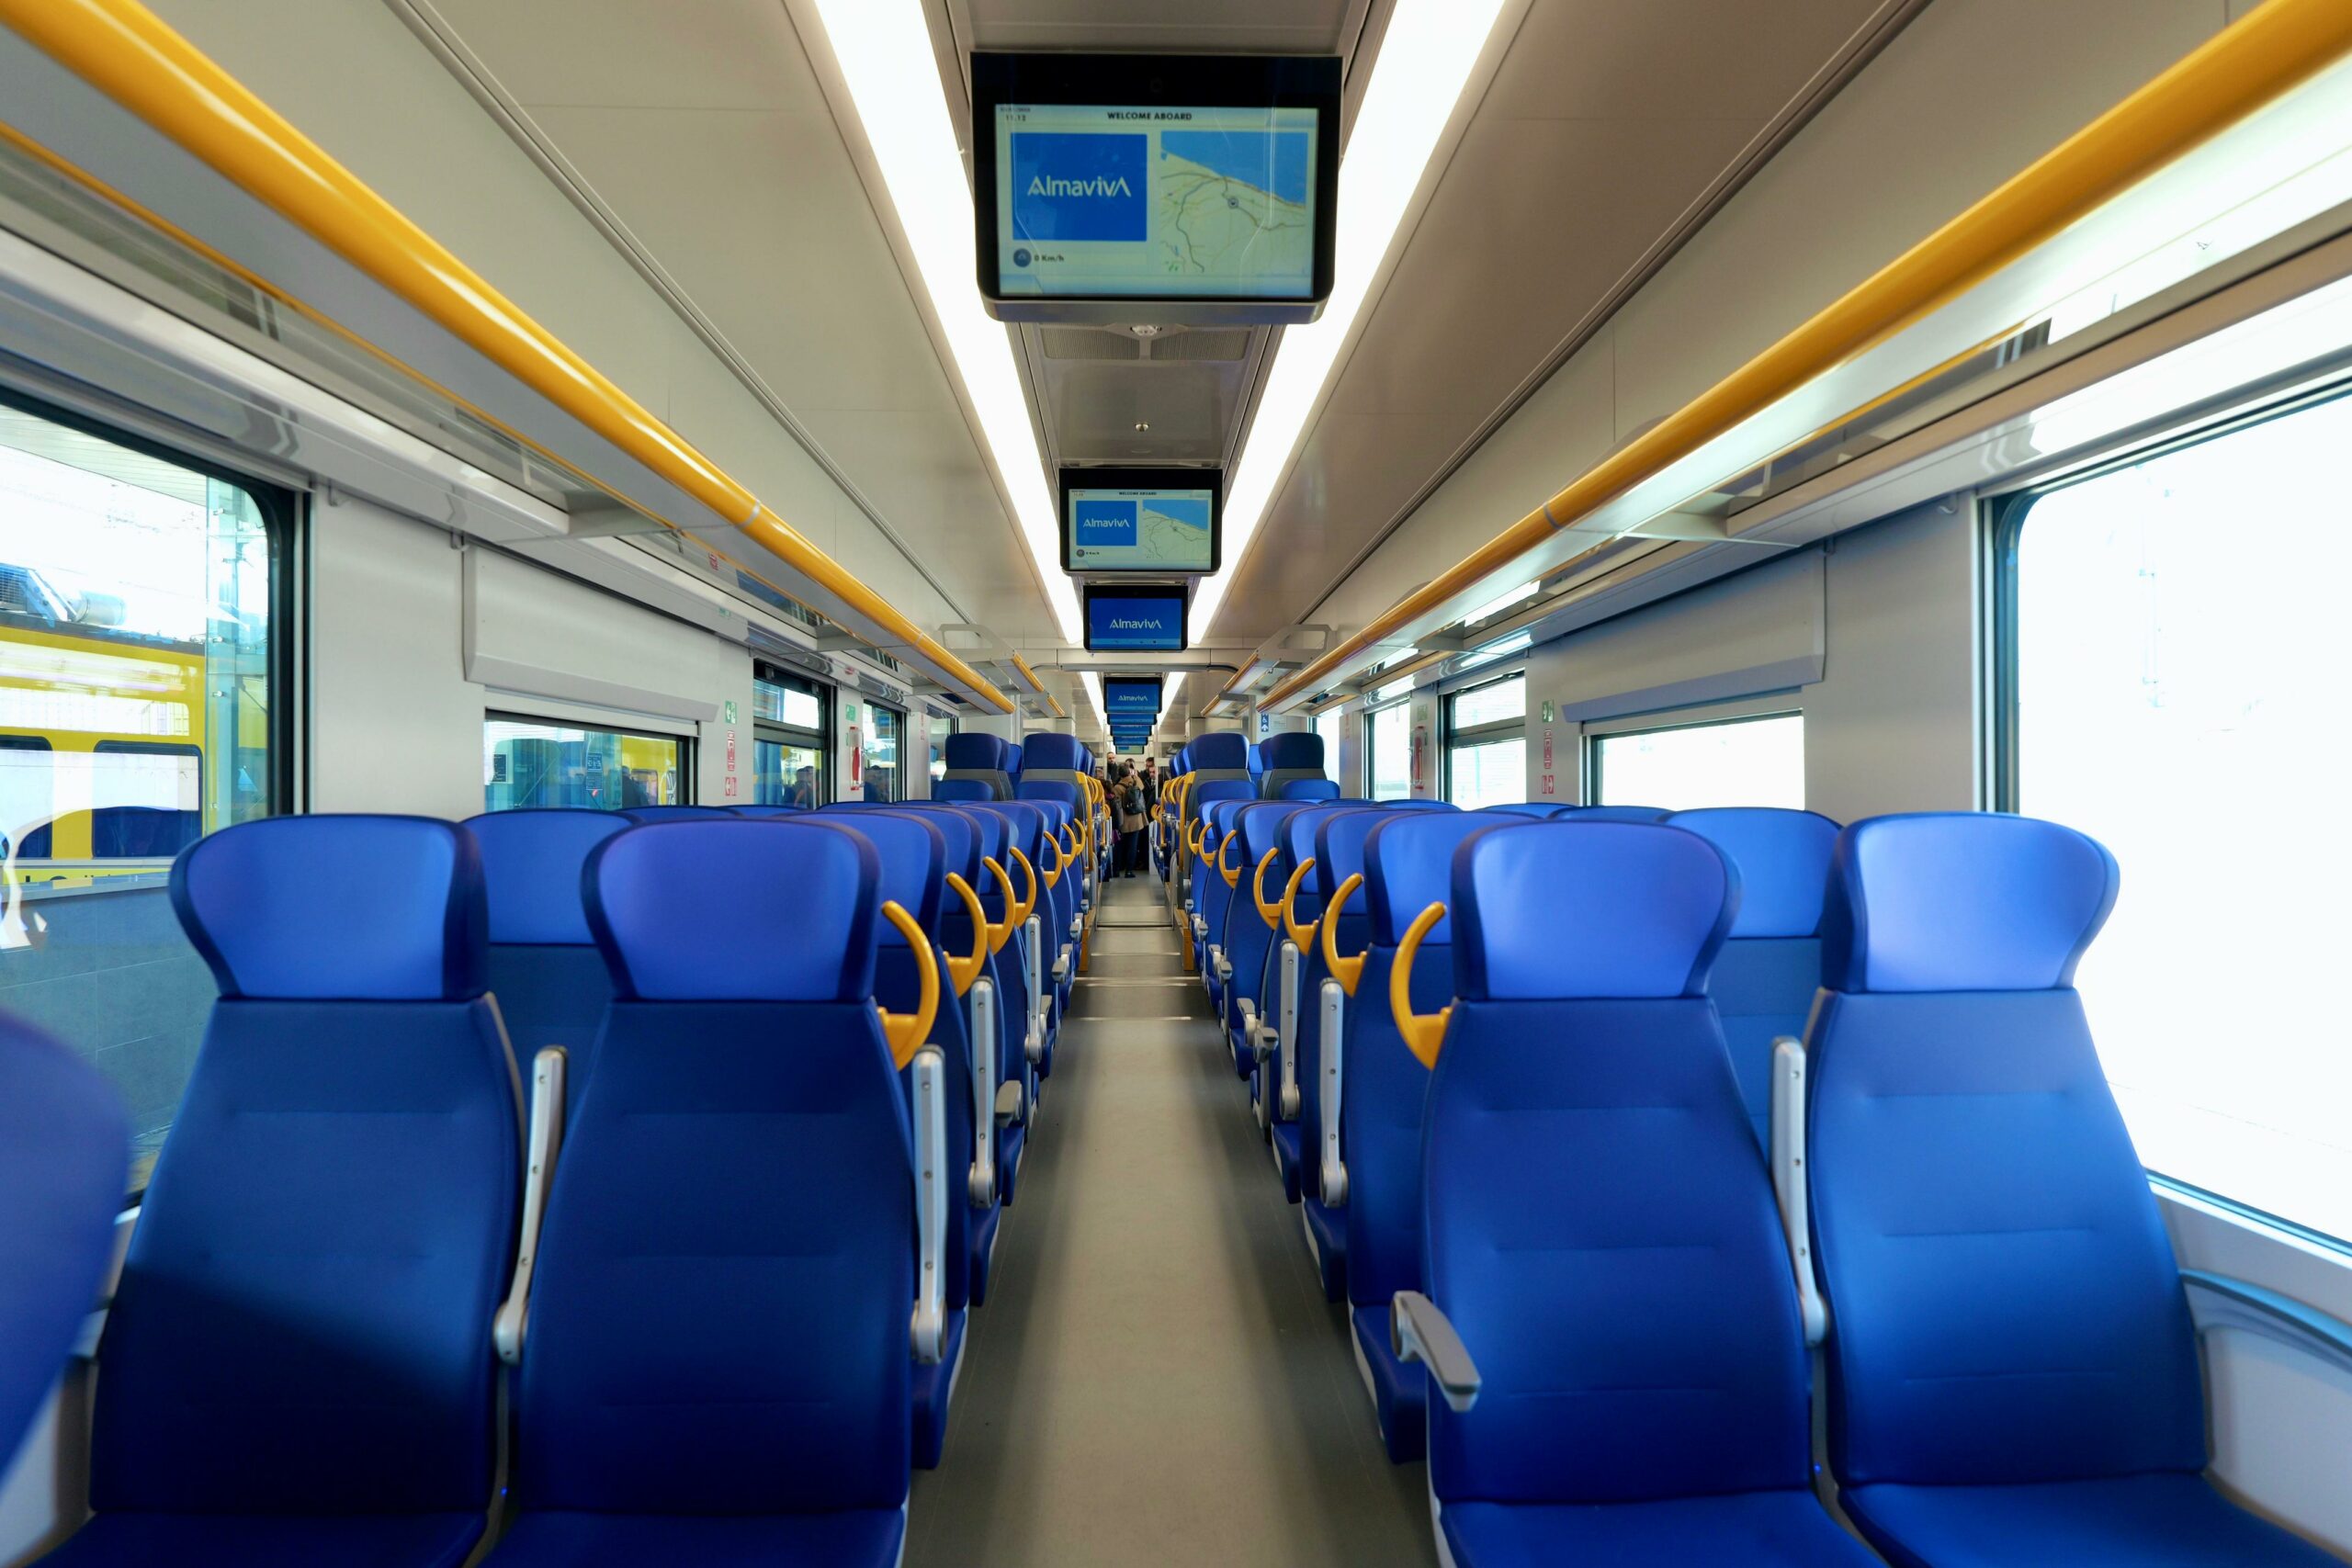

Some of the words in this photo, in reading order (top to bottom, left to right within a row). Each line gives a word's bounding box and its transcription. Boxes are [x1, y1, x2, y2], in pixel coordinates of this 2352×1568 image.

[1107, 111, 1151, 120] WELCOME
[1154, 112, 1193, 120] ABOARD
[1027, 175, 1132, 197] AlmavivA
[1082, 518, 1130, 528] AlmavivA
[1109, 618, 1162, 629] AlmavivA
